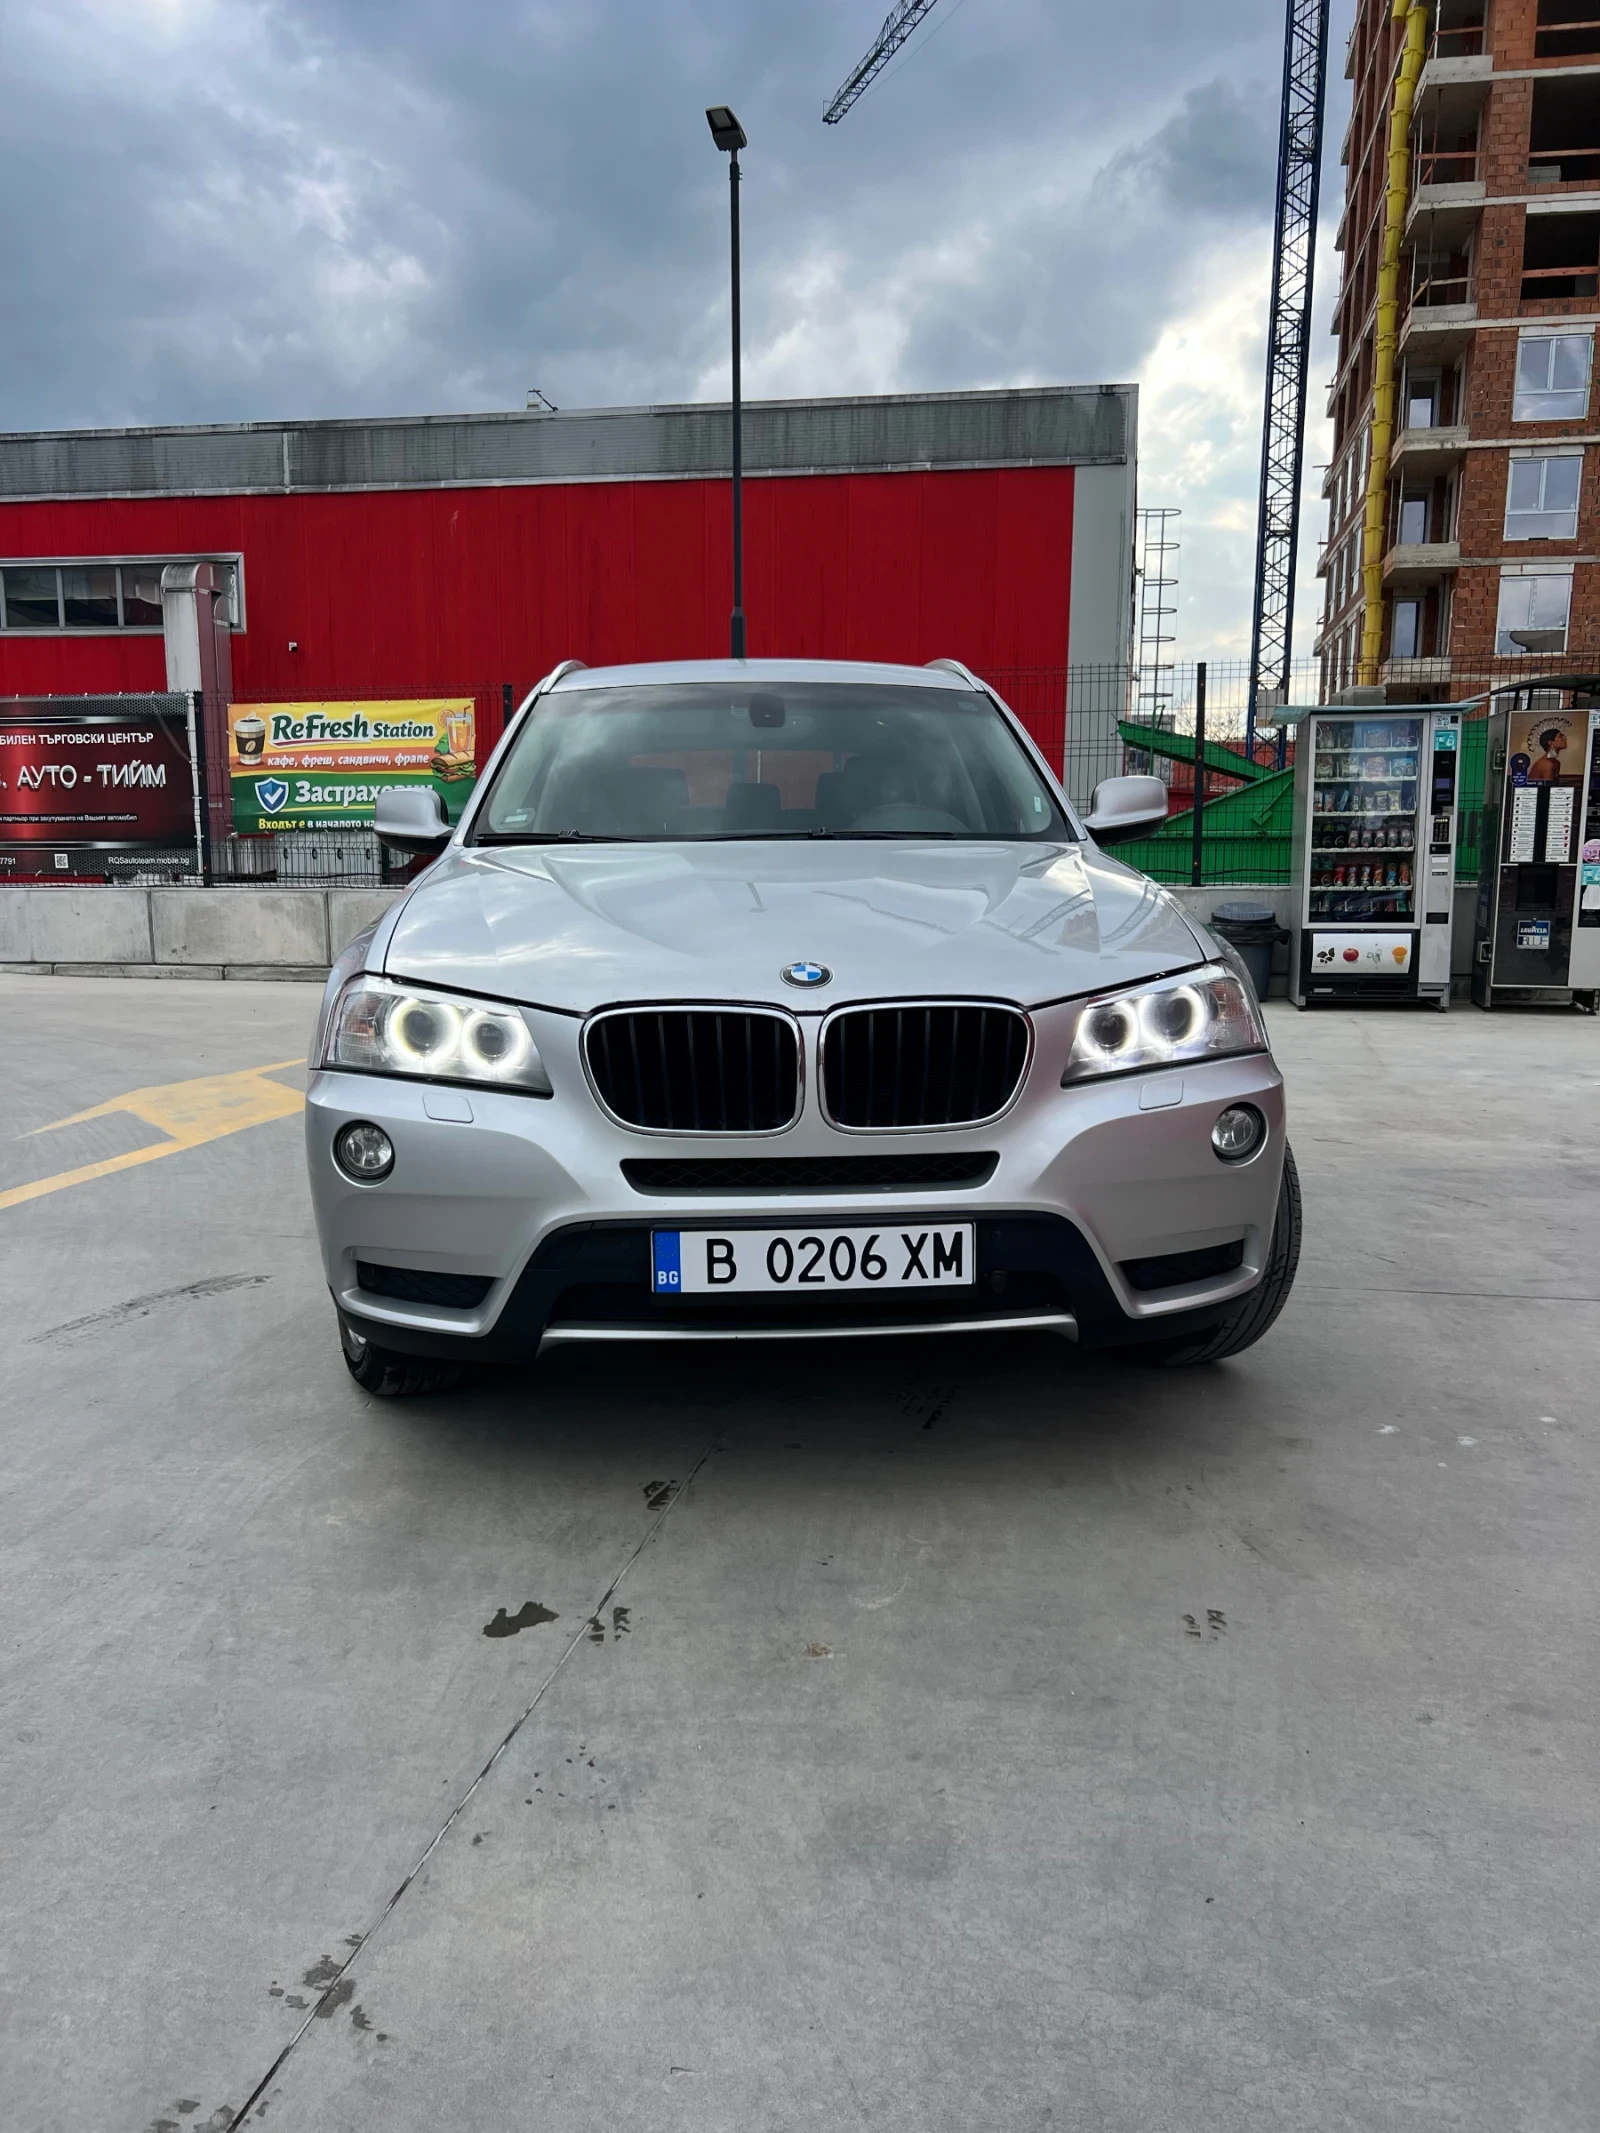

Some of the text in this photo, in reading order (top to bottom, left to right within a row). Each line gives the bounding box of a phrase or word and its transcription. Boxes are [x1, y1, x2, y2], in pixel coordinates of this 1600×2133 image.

[271, 713, 434, 740] ReFresh Station
[38, 733, 105, 745] ТЪРГОВСКИ
[107, 732, 154, 745] ЦЕНТЪР
[267, 752, 430, 768] кафе, фреш, сандвичи, фрапе
[17, 764, 78, 788] АУТО
[96, 759, 167, 788] ТИЙМ
[295, 780, 433, 807] Застрах
[258, 818, 298, 830] Входът
[298, 820, 305, 829] е
[307, 820, 314, 829] в
[315, 819, 361, 829] началото
[706, 1231, 963, 1284] B 0206 XM
[657, 1270, 679, 1285] BG
